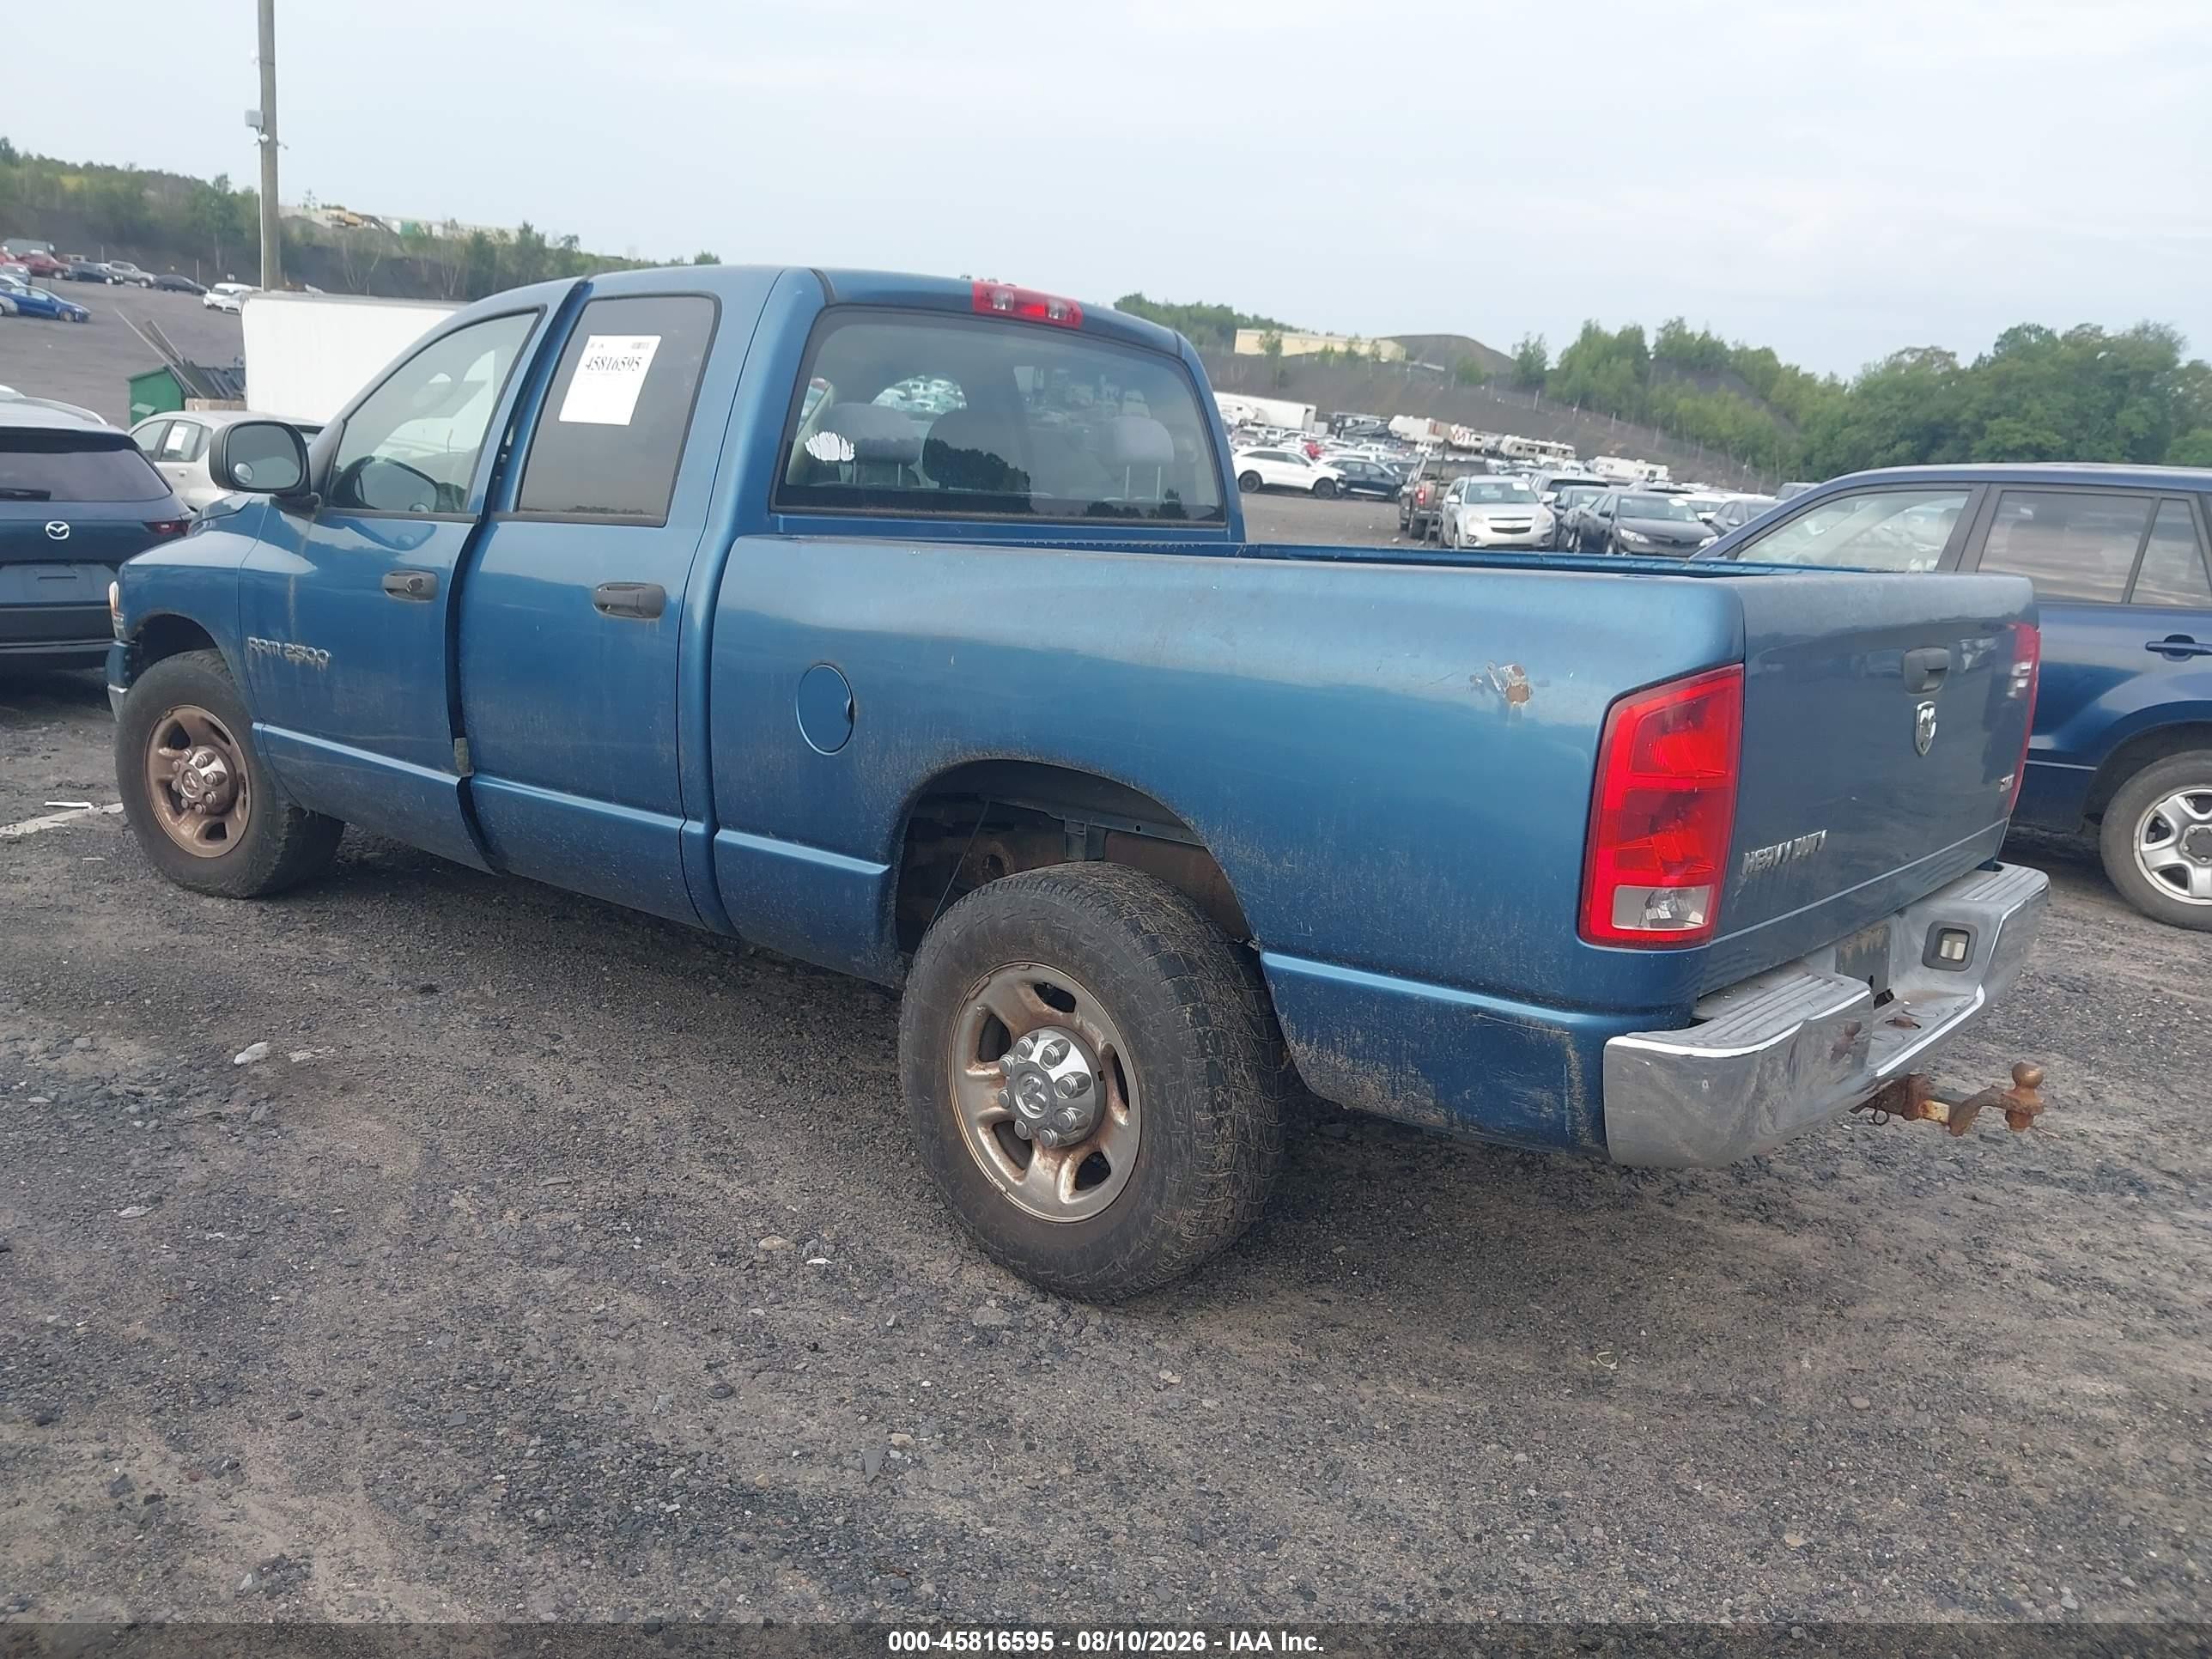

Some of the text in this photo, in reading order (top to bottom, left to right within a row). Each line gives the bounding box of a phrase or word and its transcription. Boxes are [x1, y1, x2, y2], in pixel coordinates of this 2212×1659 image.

[586, 356, 642, 371] 45816595
[247, 636, 331, 664] RAM 2500
[1741, 841, 1793, 874] HEAVY
